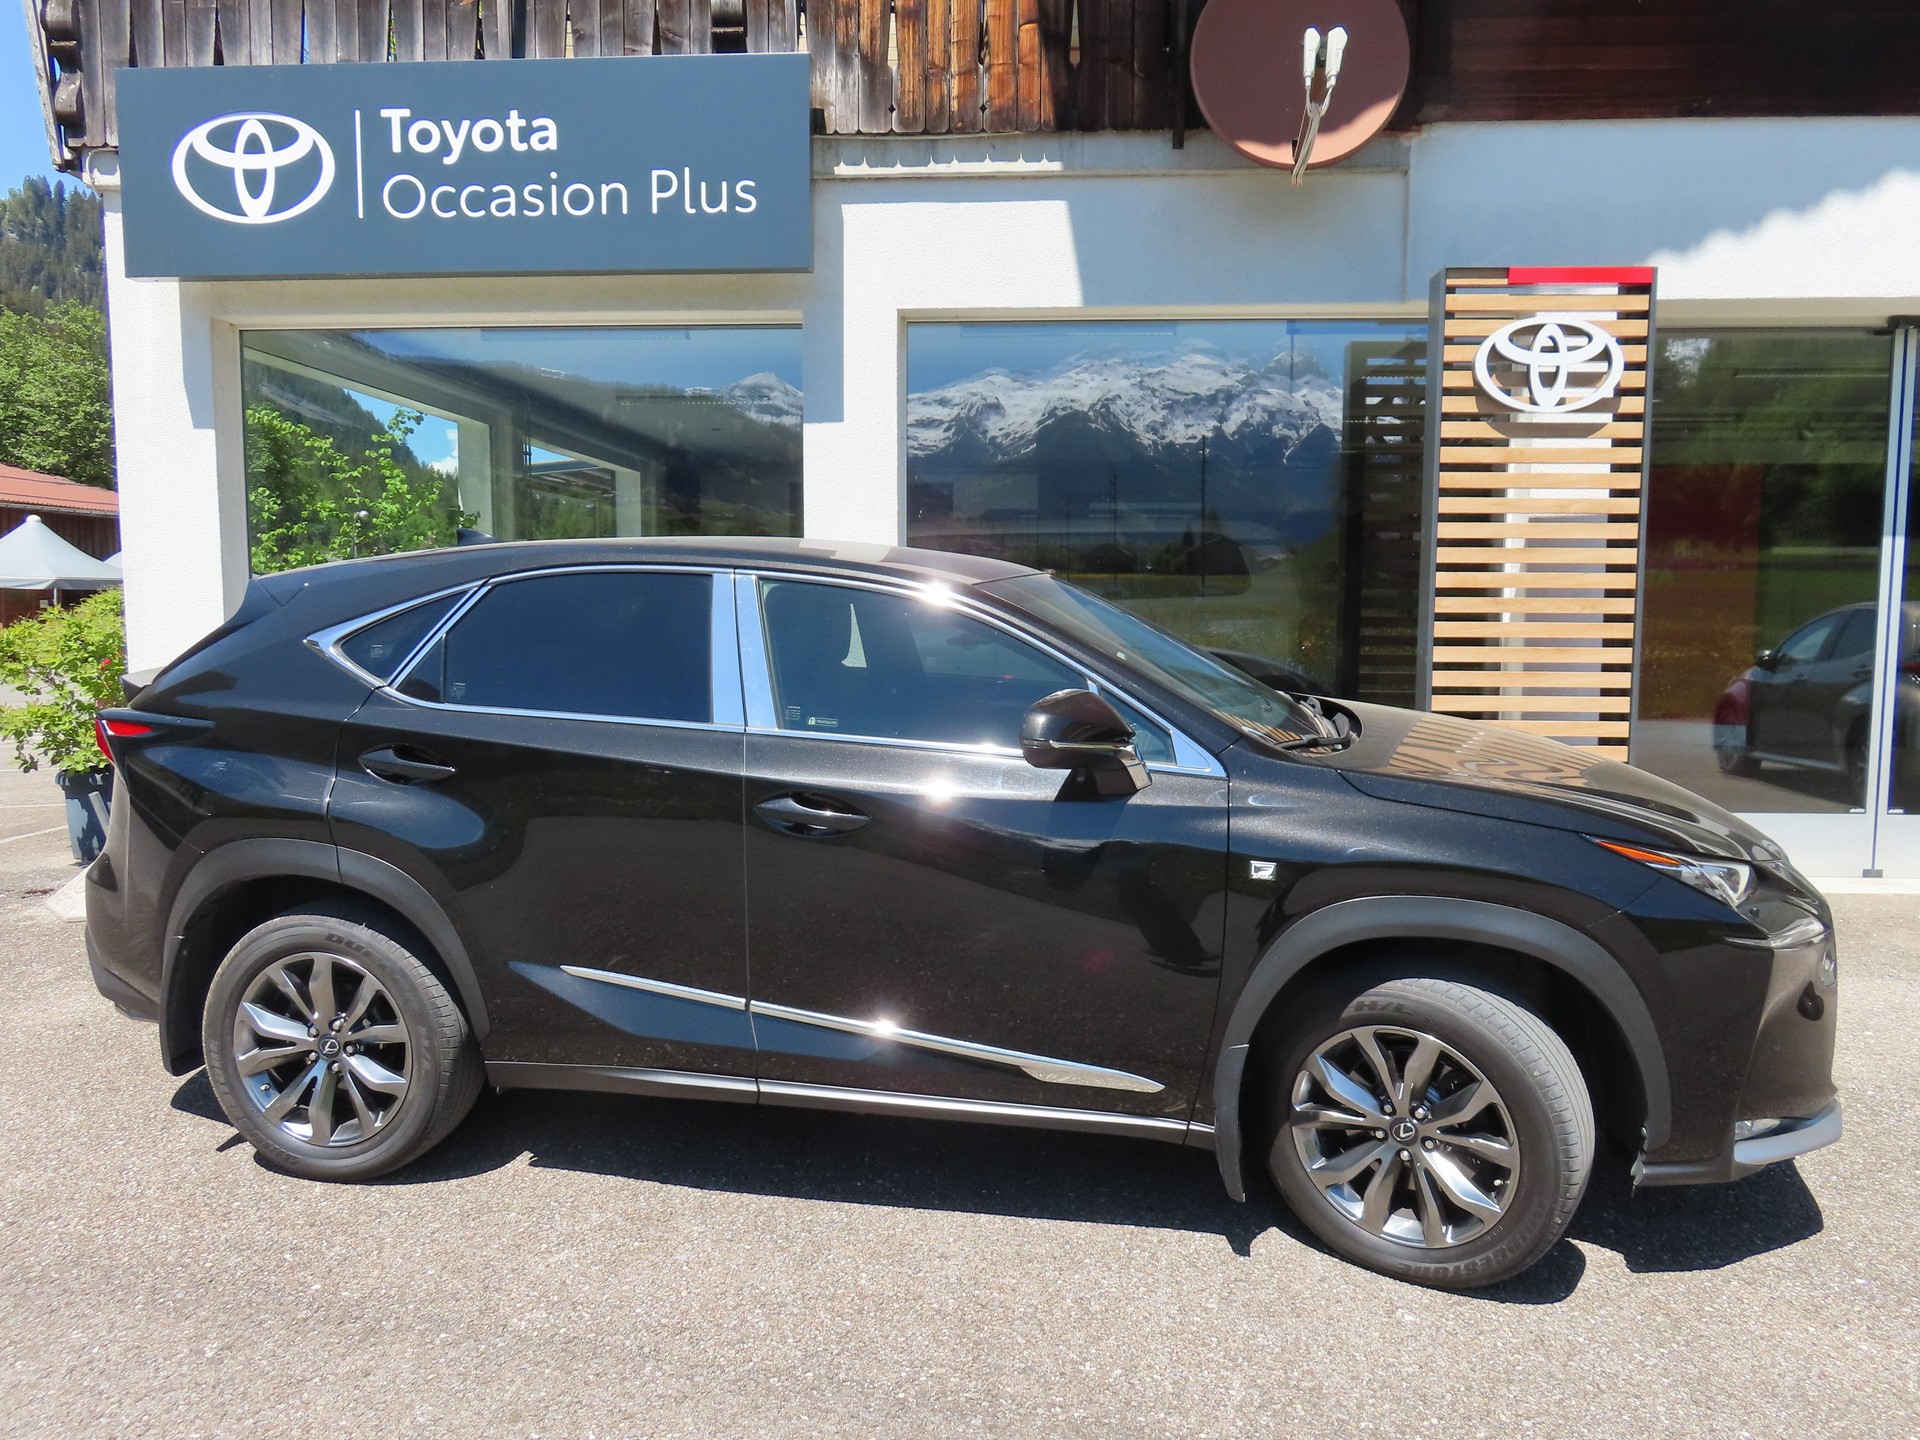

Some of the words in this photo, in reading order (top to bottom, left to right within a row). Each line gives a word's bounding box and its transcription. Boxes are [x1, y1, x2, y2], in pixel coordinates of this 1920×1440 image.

[380, 108, 558, 165] Toyota
[382, 171, 628, 219] Occasion
[651, 167, 757, 214] Plus
